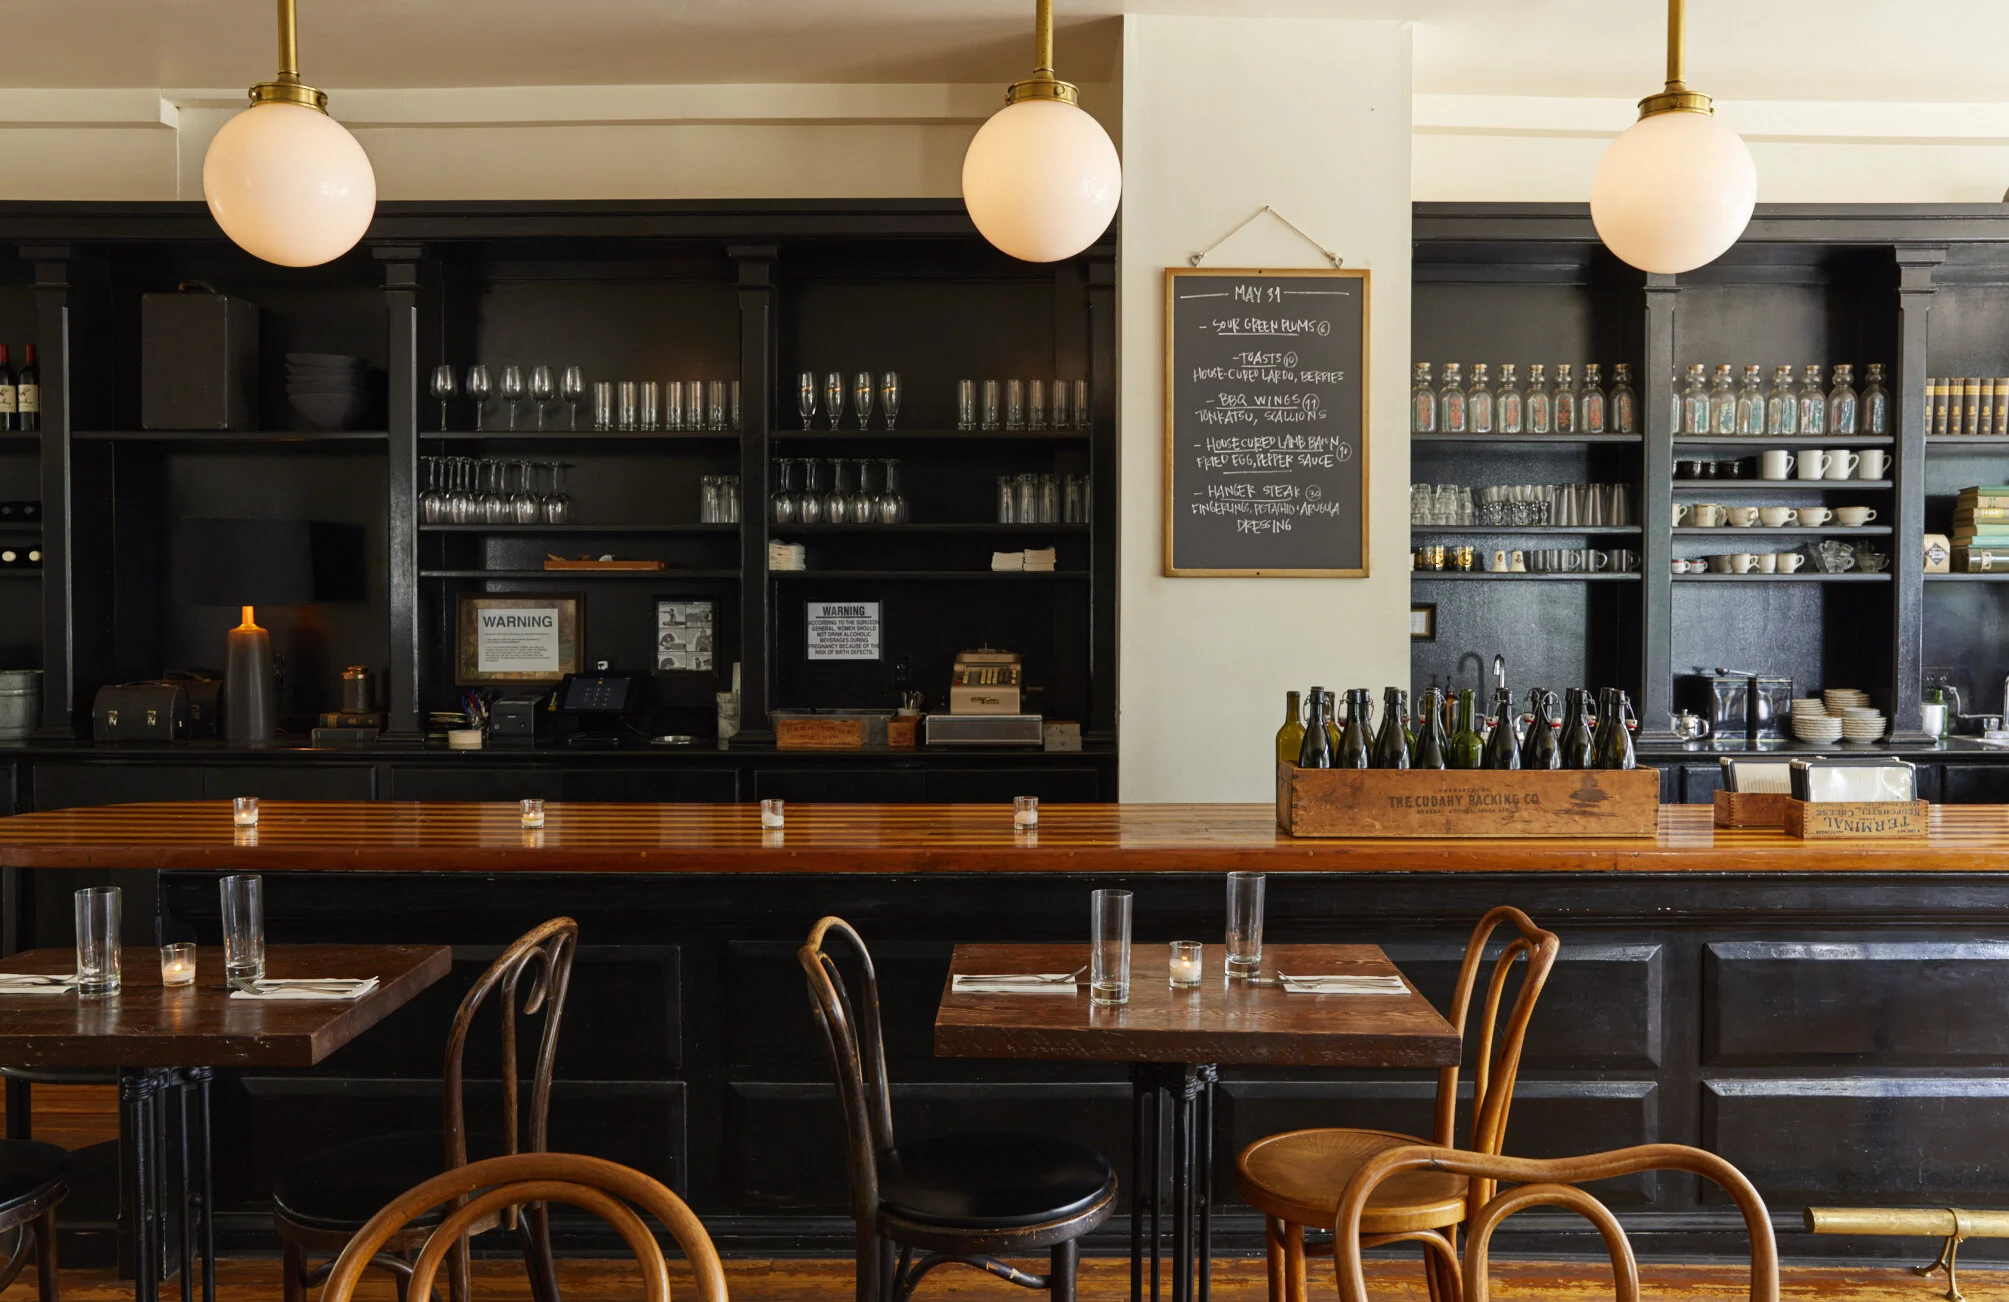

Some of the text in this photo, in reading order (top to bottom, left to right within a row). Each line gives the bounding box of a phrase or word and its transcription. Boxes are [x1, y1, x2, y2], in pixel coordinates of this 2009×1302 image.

[1235, 284, 1281, 303] MAY 31
[1212, 318, 1240, 334] SOUR
[1244, 318, 1278, 332] GREEN
[1282, 319, 1316, 332] PLUMS
[1262, 369, 1298, 384] LARDO,
[1300, 370, 1344, 384] BERRIES
[1218, 392, 1248, 407] BBQ
[1254, 394, 1301, 407] WINGS
[1264, 409, 1328, 422] SCALLIONS
[1278, 434, 1306, 450] LAMB
[1196, 454, 1228, 471] FRIED
[1298, 454, 1334, 468] SAUCE
[1208, 484, 1256, 498] HANGER
[1262, 484, 1300, 498] STEAK
[1237, 518, 1292, 534] DRESSING
[822, 606, 865, 616] WARNING
[483, 616, 552, 628] WARNING
[1388, 795, 1412, 808] THE
[1415, 794, 1463, 808] CUDAHY
[1468, 793, 1520, 806] PACKING
[1816, 809, 1854, 817] CHEESE
[1824, 816, 1910, 833] TERMINAL
